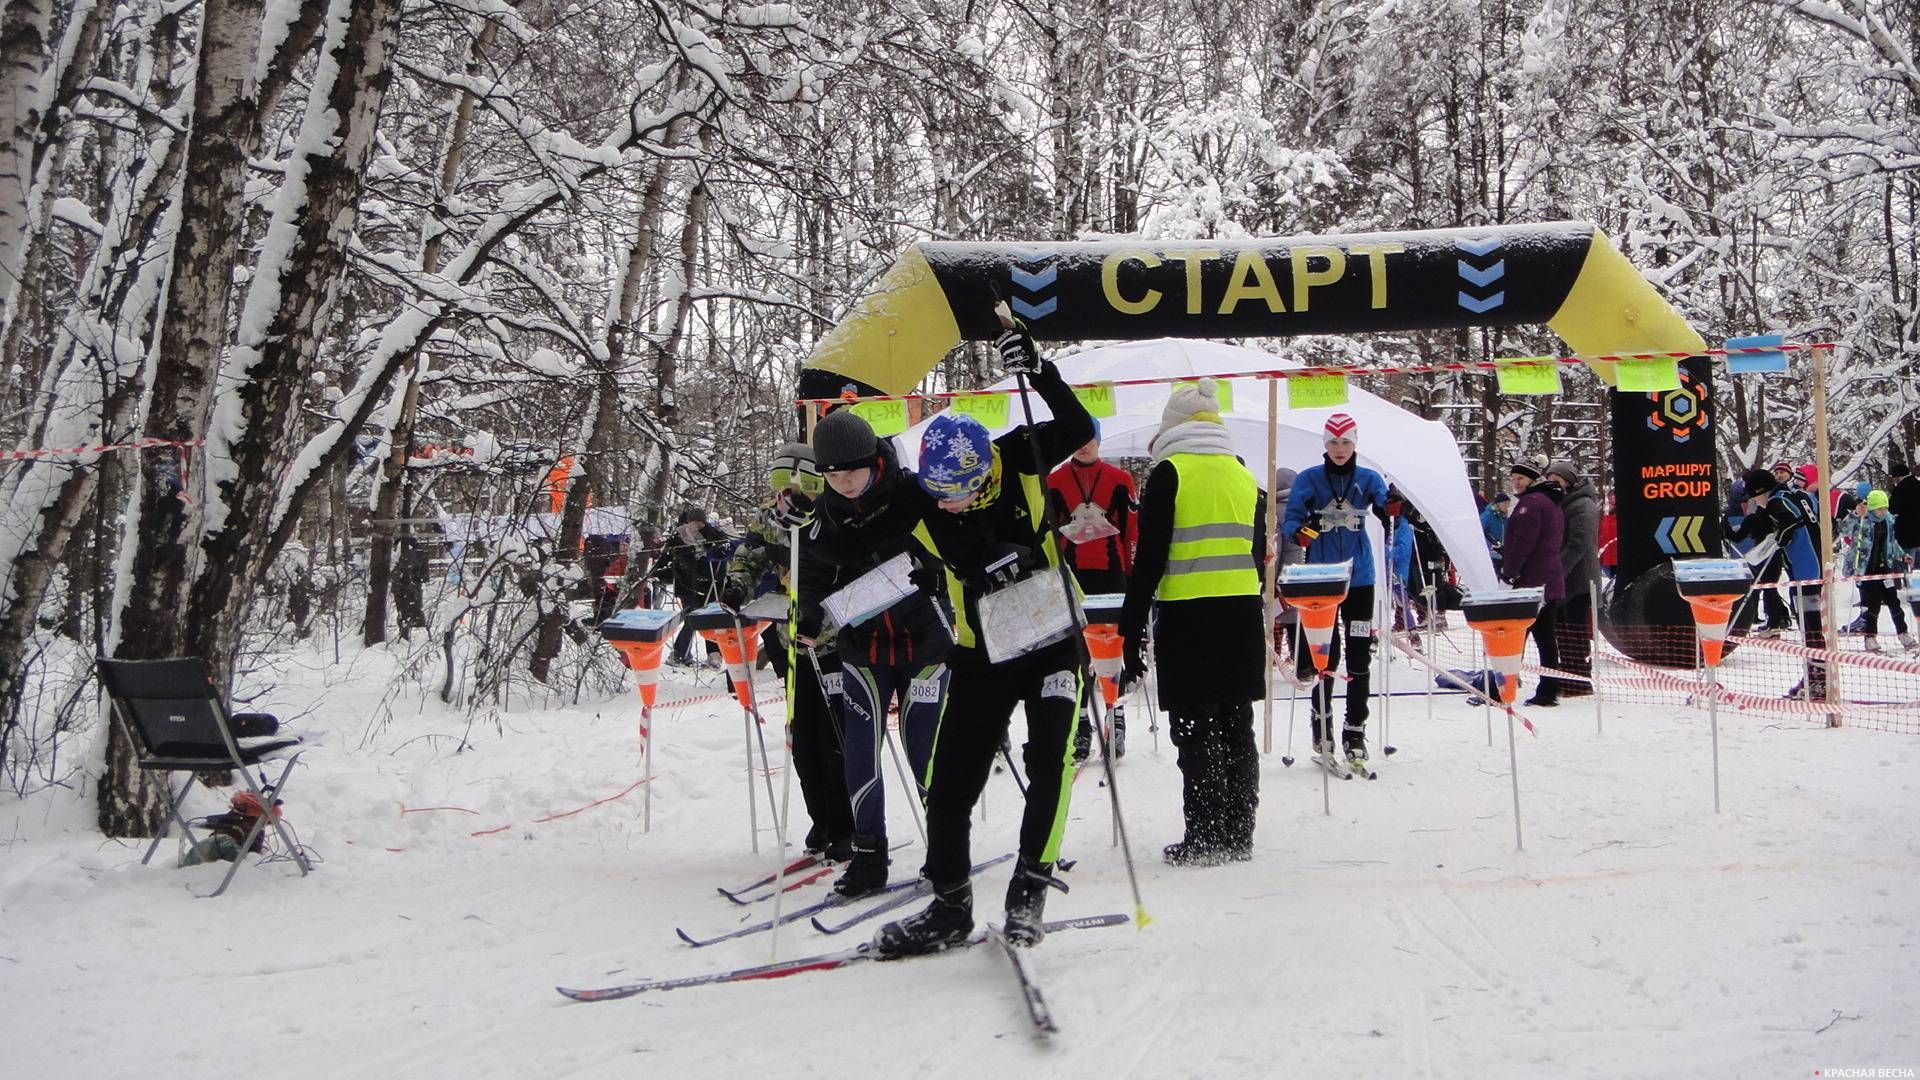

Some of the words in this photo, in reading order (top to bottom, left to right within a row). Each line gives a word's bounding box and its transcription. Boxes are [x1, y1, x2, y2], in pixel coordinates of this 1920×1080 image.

[1100, 244, 1404, 316] СТАРТ
[1641, 463, 1712, 479] МАРШРУТ
[1643, 481, 1711, 499] GROUP
[911, 685, 937, 698] 3082
